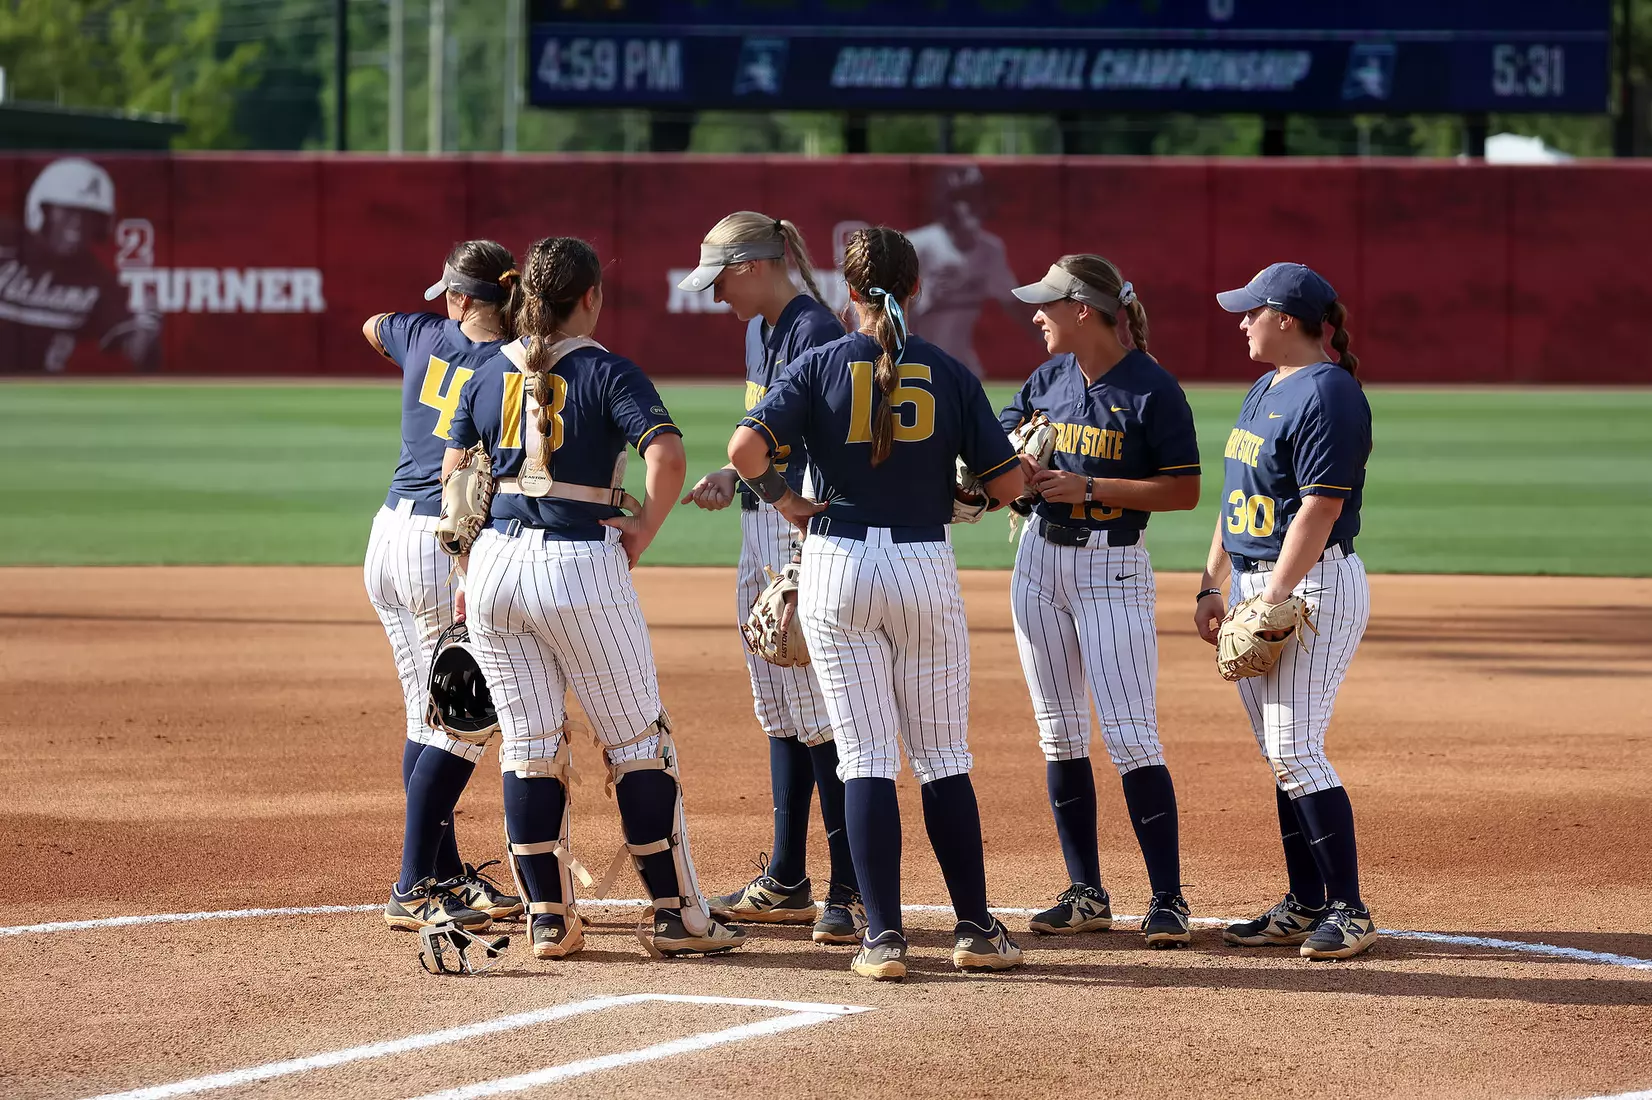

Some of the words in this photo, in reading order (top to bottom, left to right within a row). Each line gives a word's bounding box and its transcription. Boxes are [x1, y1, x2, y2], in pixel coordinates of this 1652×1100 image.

[537, 38, 617, 91] 4:59
[624, 39, 683, 91] PM
[949, 47, 1088, 89] SOFTBALL
[1091, 49, 1312, 91] CHAMPIONSHIP
[1492, 45, 1566, 96] 5:31
[115, 218, 154, 268] 2
[118, 266, 325, 313] TURNER
[419, 354, 475, 440] 4
[845, 361, 936, 445] 15
[1081, 425, 1124, 460] STATE
[1226, 489, 1275, 538] 30
